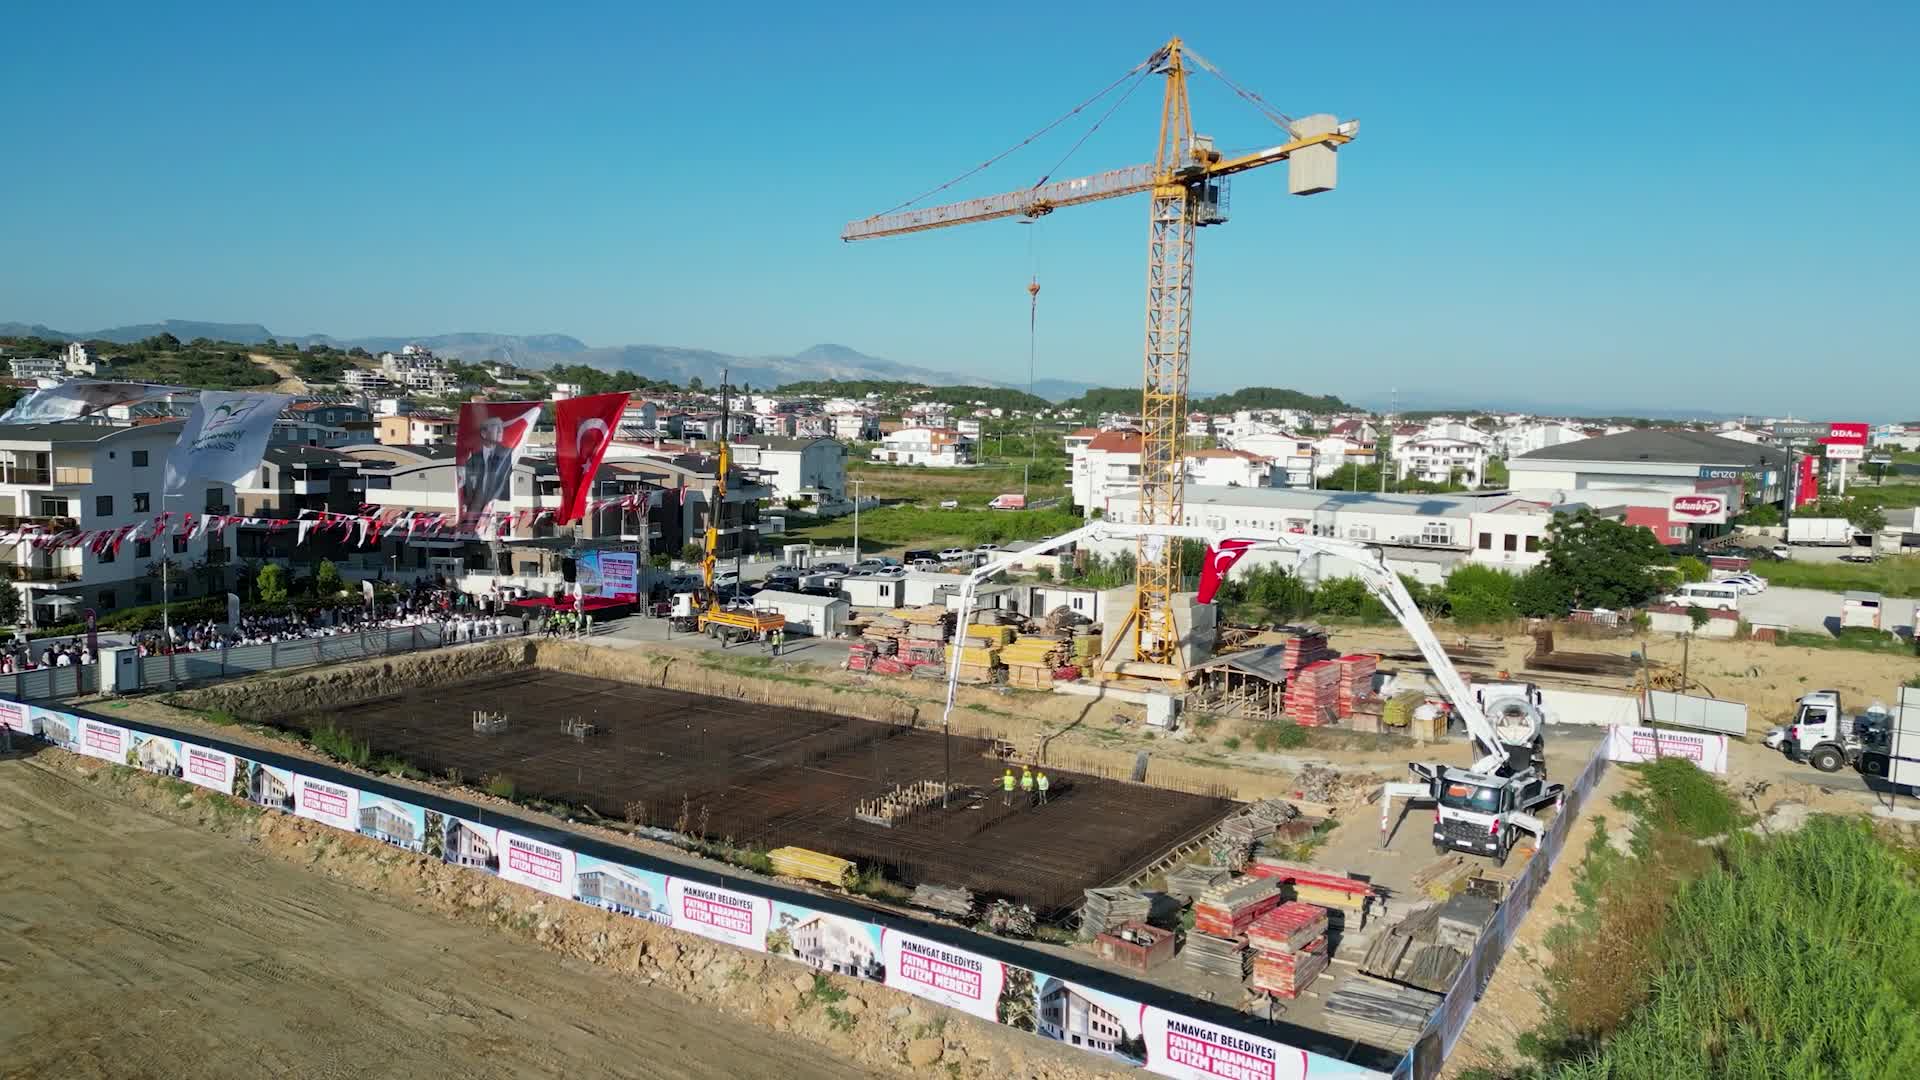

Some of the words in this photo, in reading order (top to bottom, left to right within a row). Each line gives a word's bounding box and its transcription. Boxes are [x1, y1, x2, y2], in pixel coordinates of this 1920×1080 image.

[1710, 469, 1736, 479] enza
[684, 886, 716, 901] MANAVGAT
[902, 940, 939, 959] MANAVGAT
[942, 952, 982, 972] BELEDİYESİ
[1167, 1019, 1218, 1043] MANAVGAT
[1221, 1034, 1276, 1060] BELEDİYESİ
[1169, 1034, 1204, 1055] FATMA
[1205, 1044, 1272, 1076] KARAMANCI
